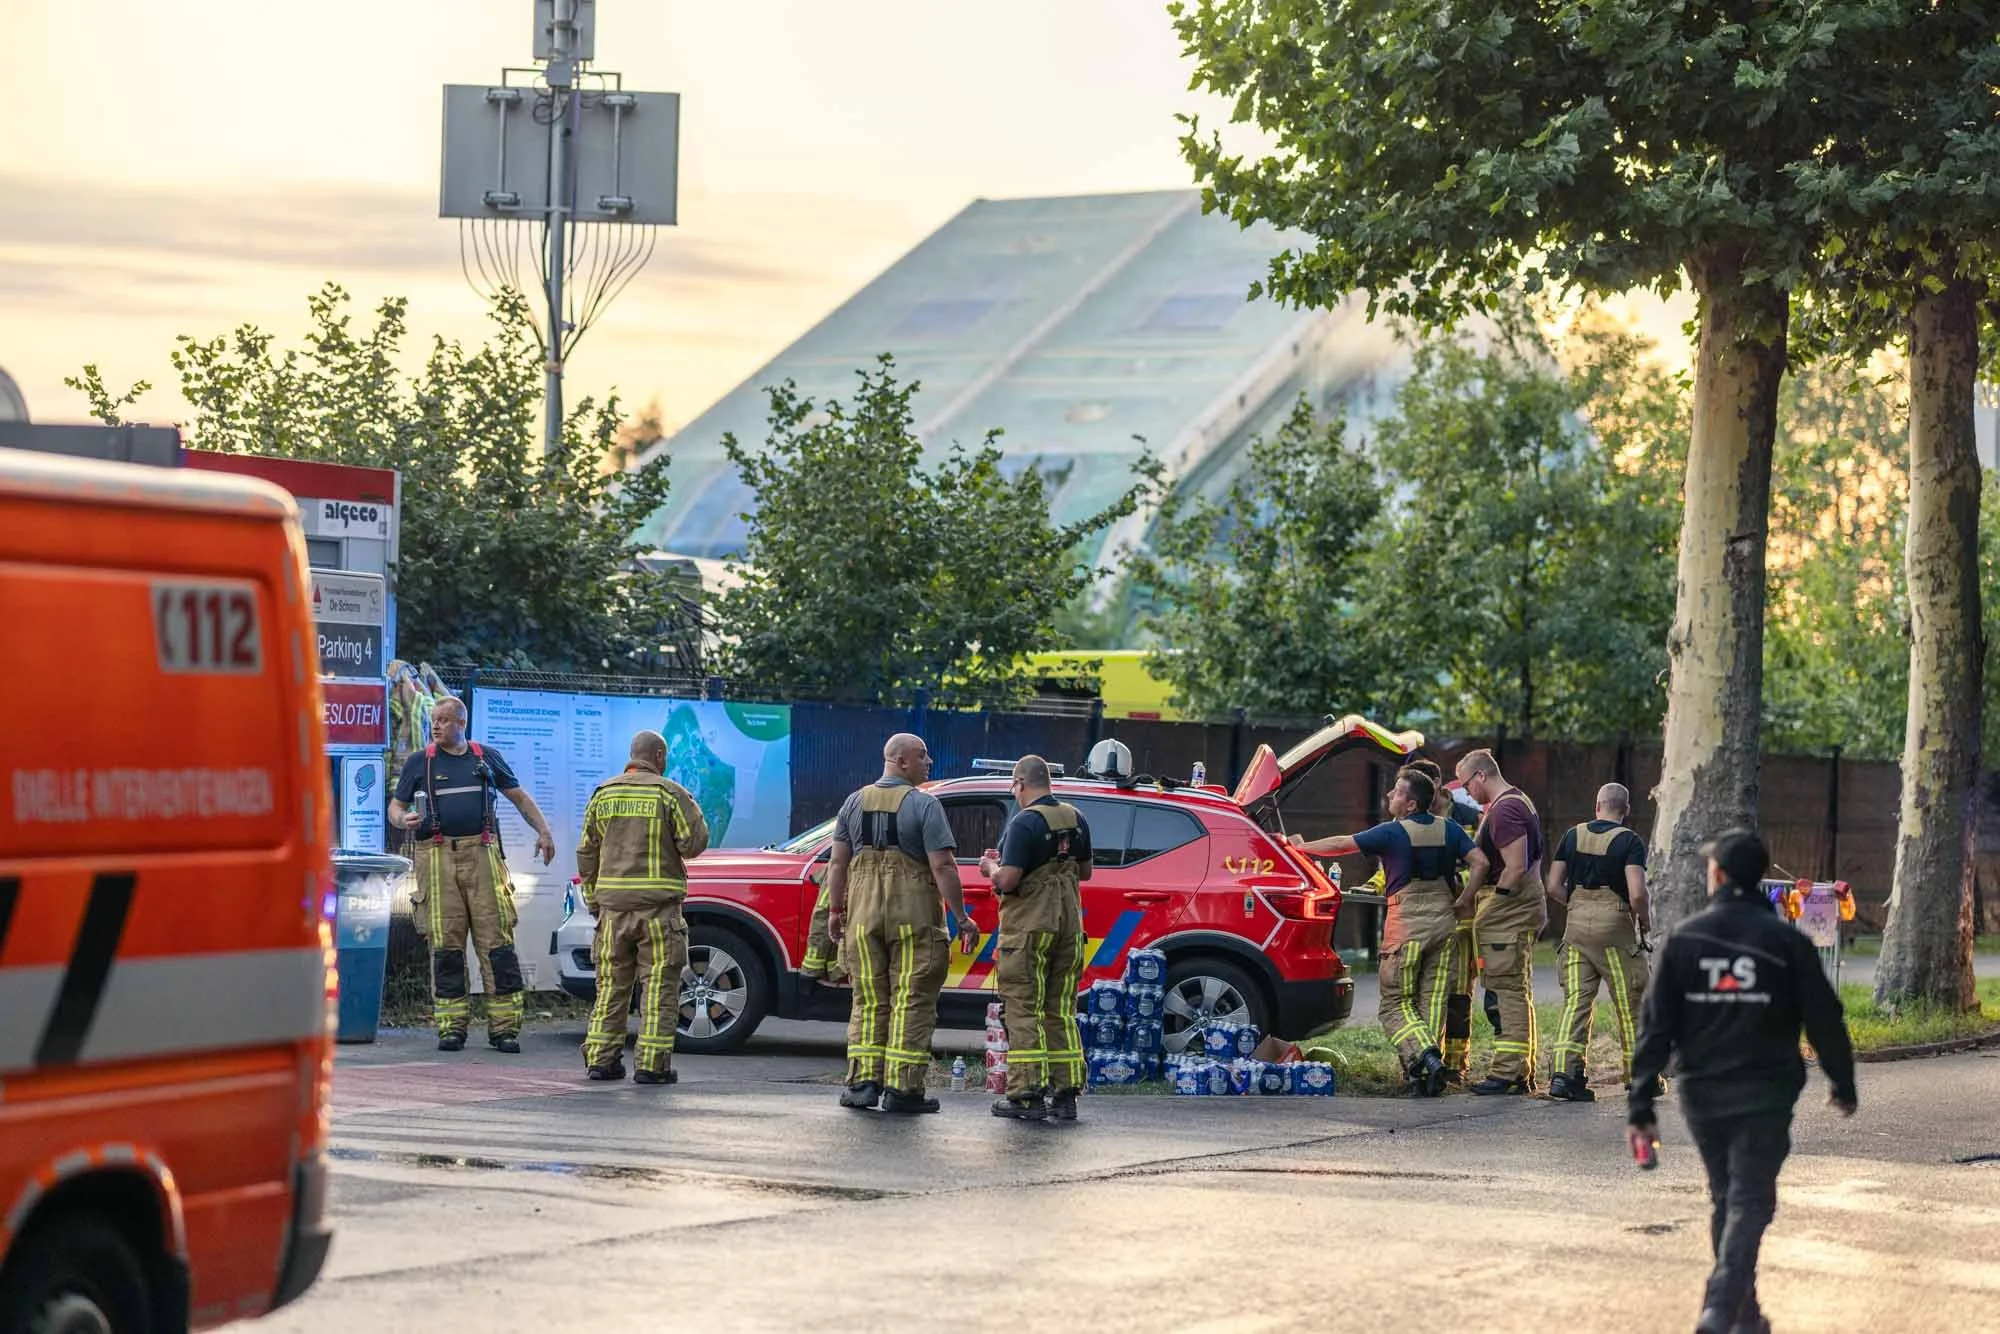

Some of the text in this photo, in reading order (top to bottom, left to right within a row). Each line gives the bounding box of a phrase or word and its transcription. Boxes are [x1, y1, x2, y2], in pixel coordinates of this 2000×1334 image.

[325, 502, 378, 528] algeco
[181, 588, 257, 667] 112
[318, 634, 373, 665] Parking 4
[321, 703, 381, 725] ESLOTEN
[597, 799, 656, 816] BRNDWEER
[1238, 857, 1275, 875] 112
